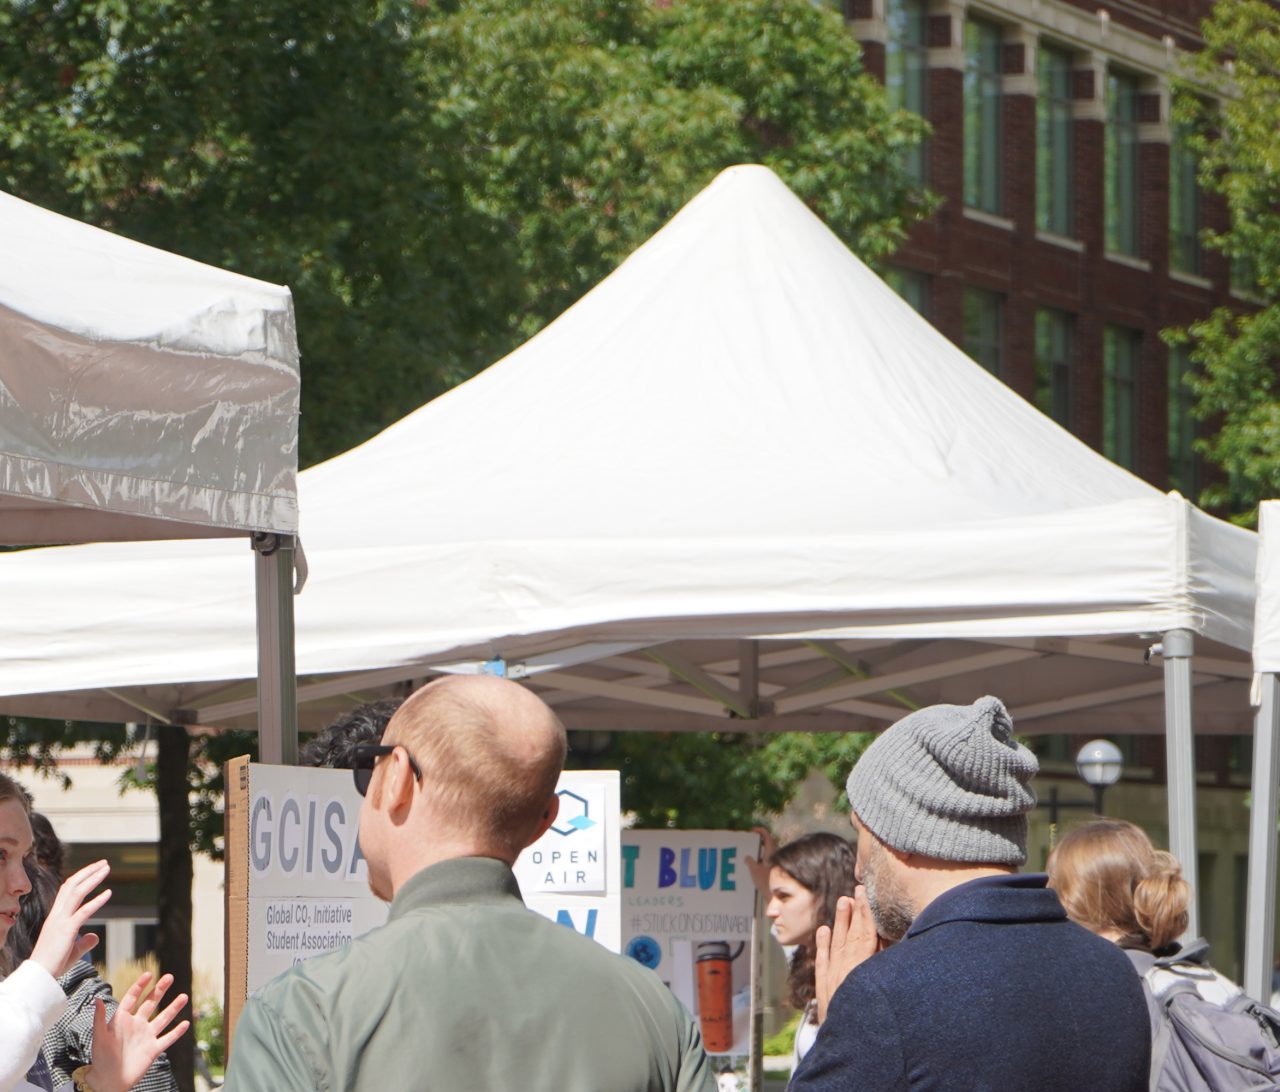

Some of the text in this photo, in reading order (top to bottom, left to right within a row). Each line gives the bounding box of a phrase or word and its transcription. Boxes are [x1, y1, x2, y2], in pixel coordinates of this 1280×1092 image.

[532, 849, 598, 865] OPEN
[544, 871, 587, 884] AIR
[658, 846, 737, 891] BLUE
[628, 895, 684, 908] LEADERS
[266, 904, 293, 925] Global
[313, 903, 352, 924] Initiative
[266, 930, 353, 951] Student Association
